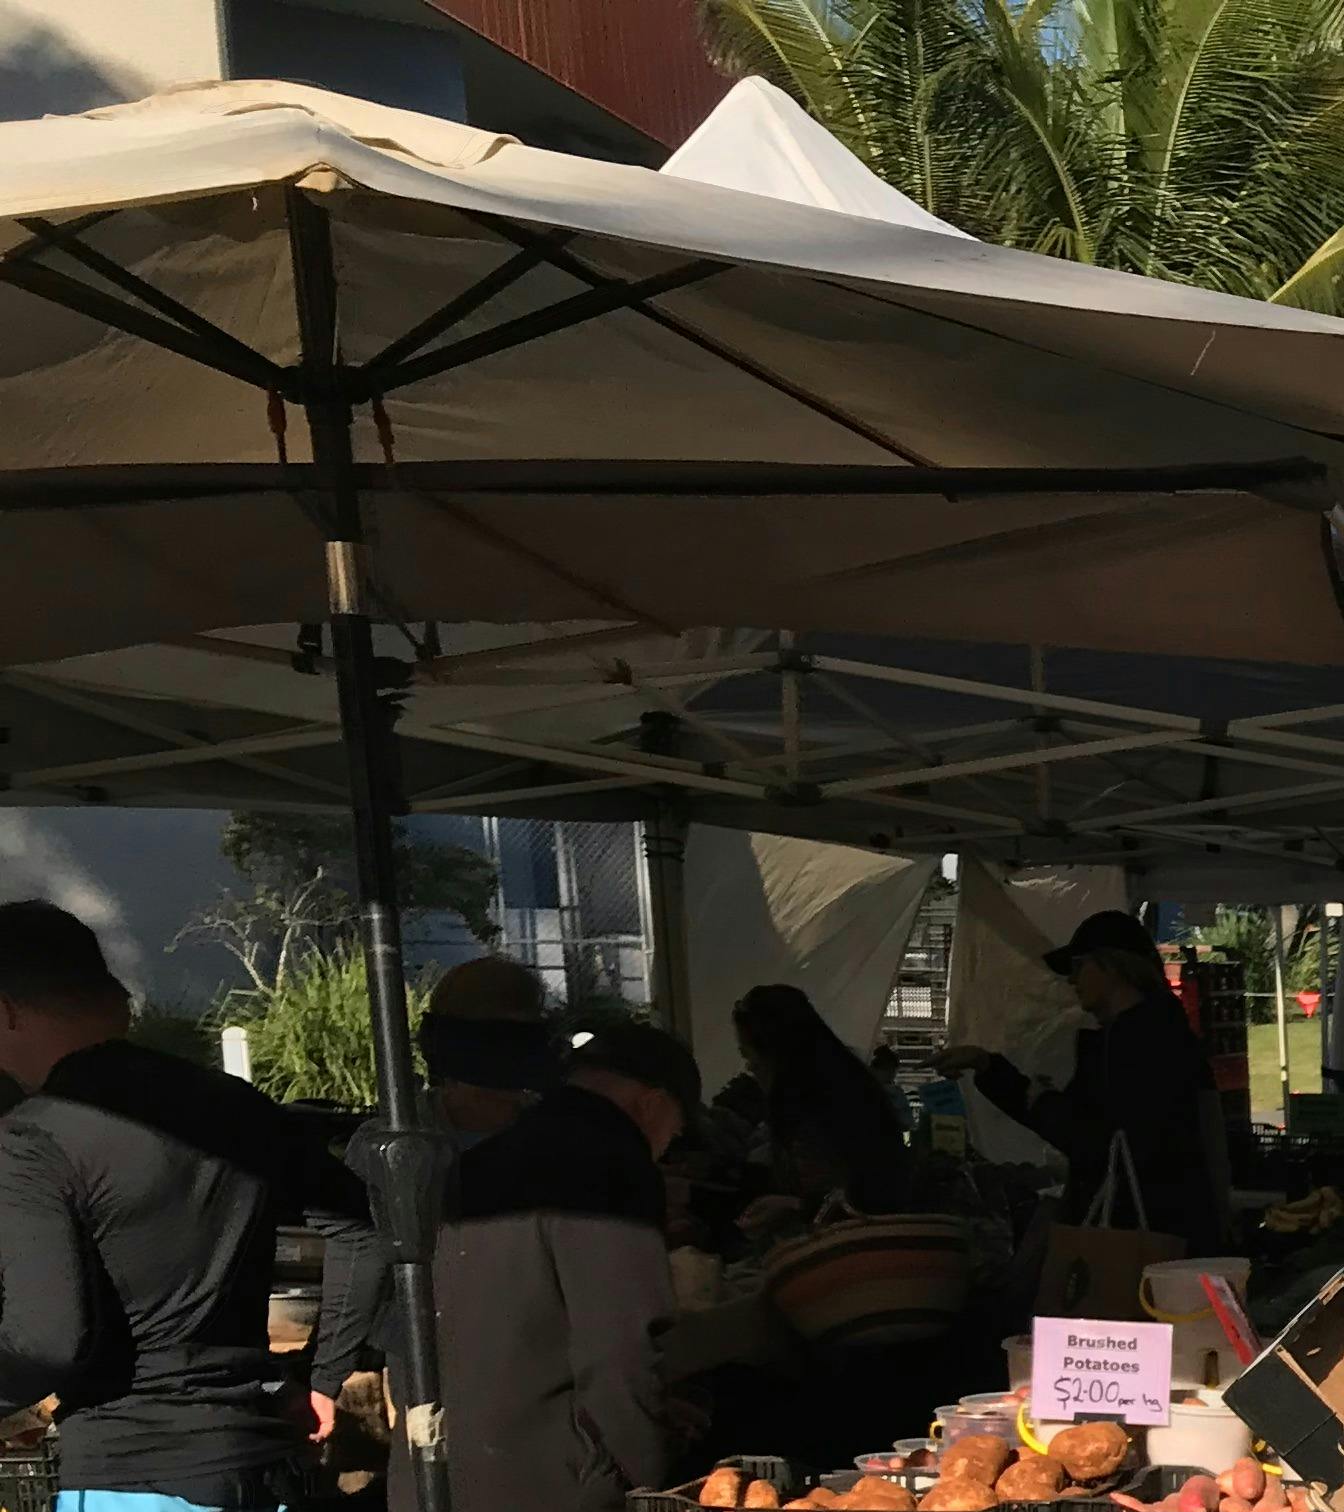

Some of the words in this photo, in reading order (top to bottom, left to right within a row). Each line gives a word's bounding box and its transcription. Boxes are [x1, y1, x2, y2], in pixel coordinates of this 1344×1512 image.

[1068, 1335, 1138, 1351] Brushed
[1064, 1357, 1140, 1373] Potatoes
[1118, 1398, 1136, 1408] per
